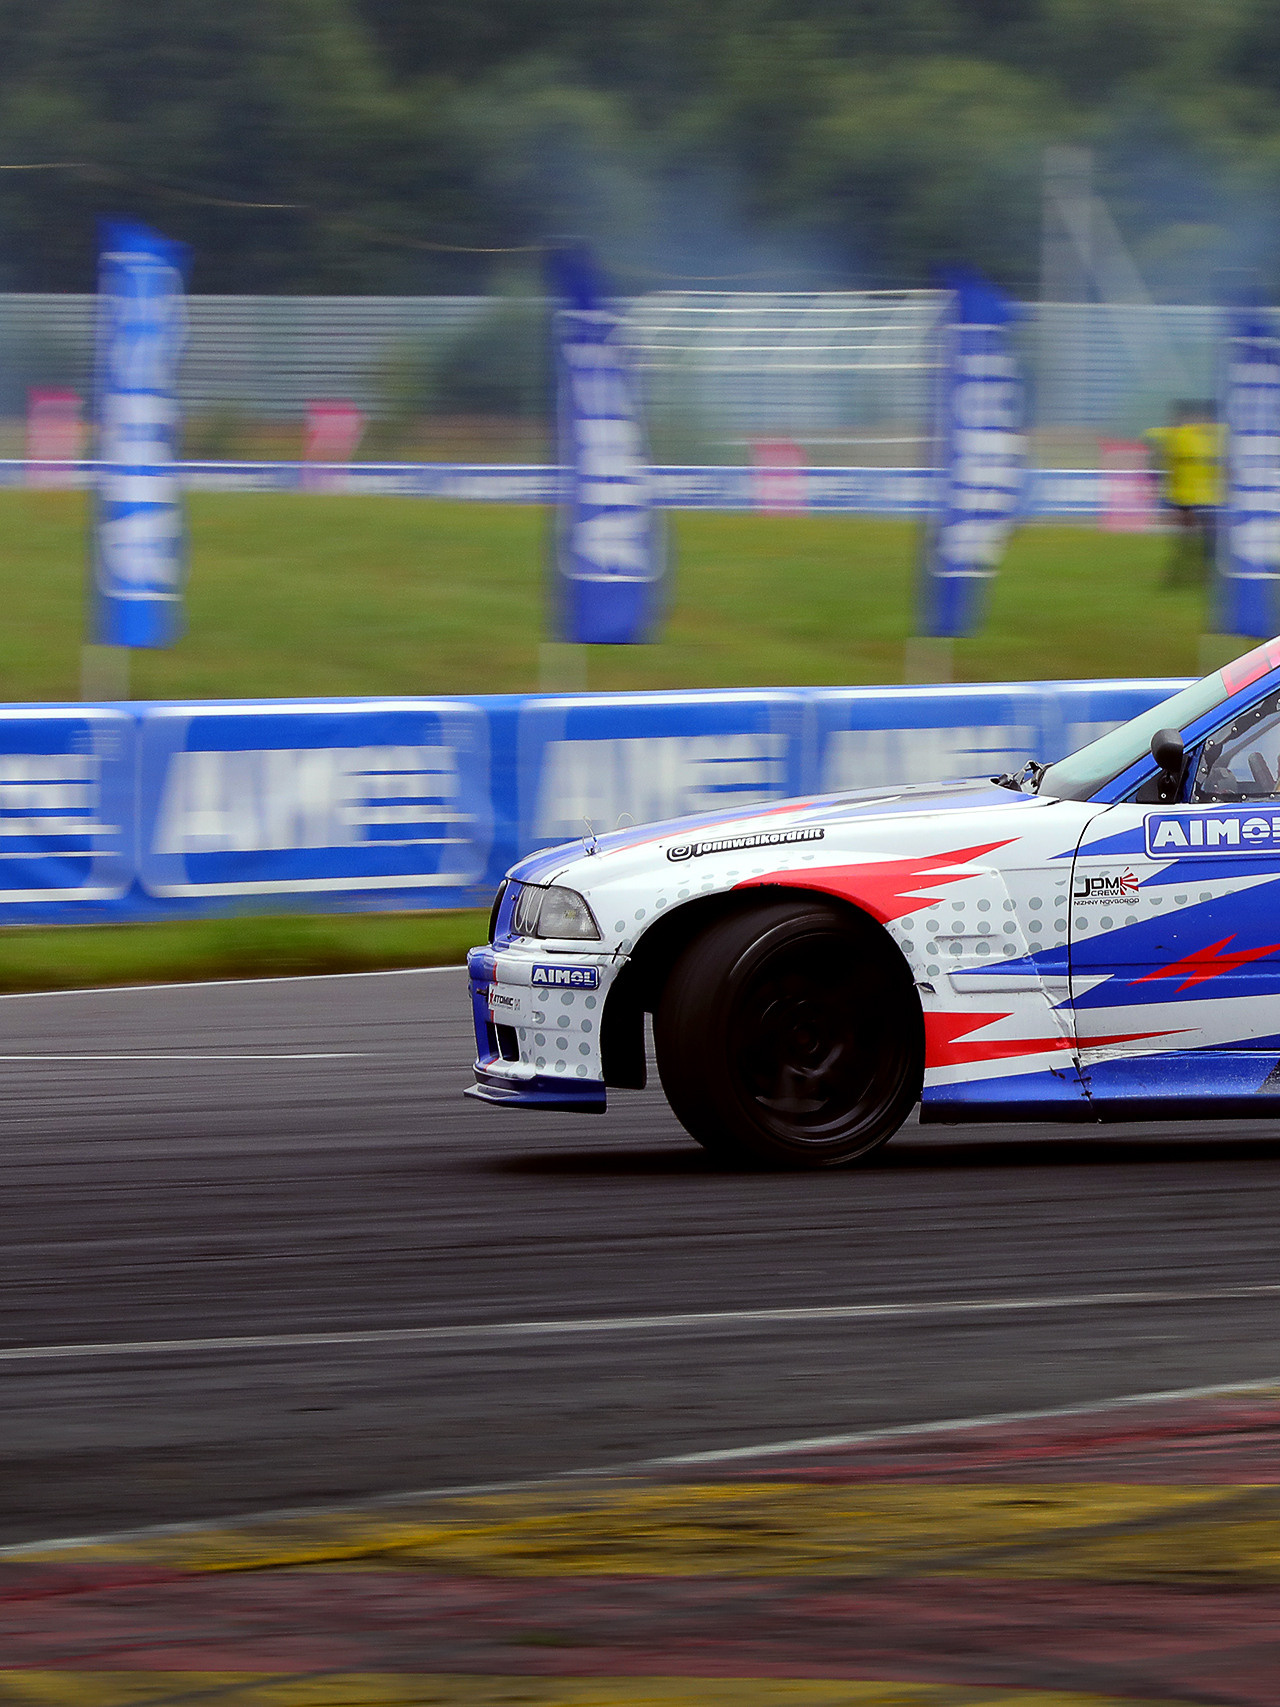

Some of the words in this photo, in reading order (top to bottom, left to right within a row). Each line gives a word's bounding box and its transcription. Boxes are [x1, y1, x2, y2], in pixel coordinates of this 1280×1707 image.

[1074, 877, 1119, 897] JDM
[1100, 898, 1140, 906] NOVGOROD
[533, 968, 595, 986] AIMOL
